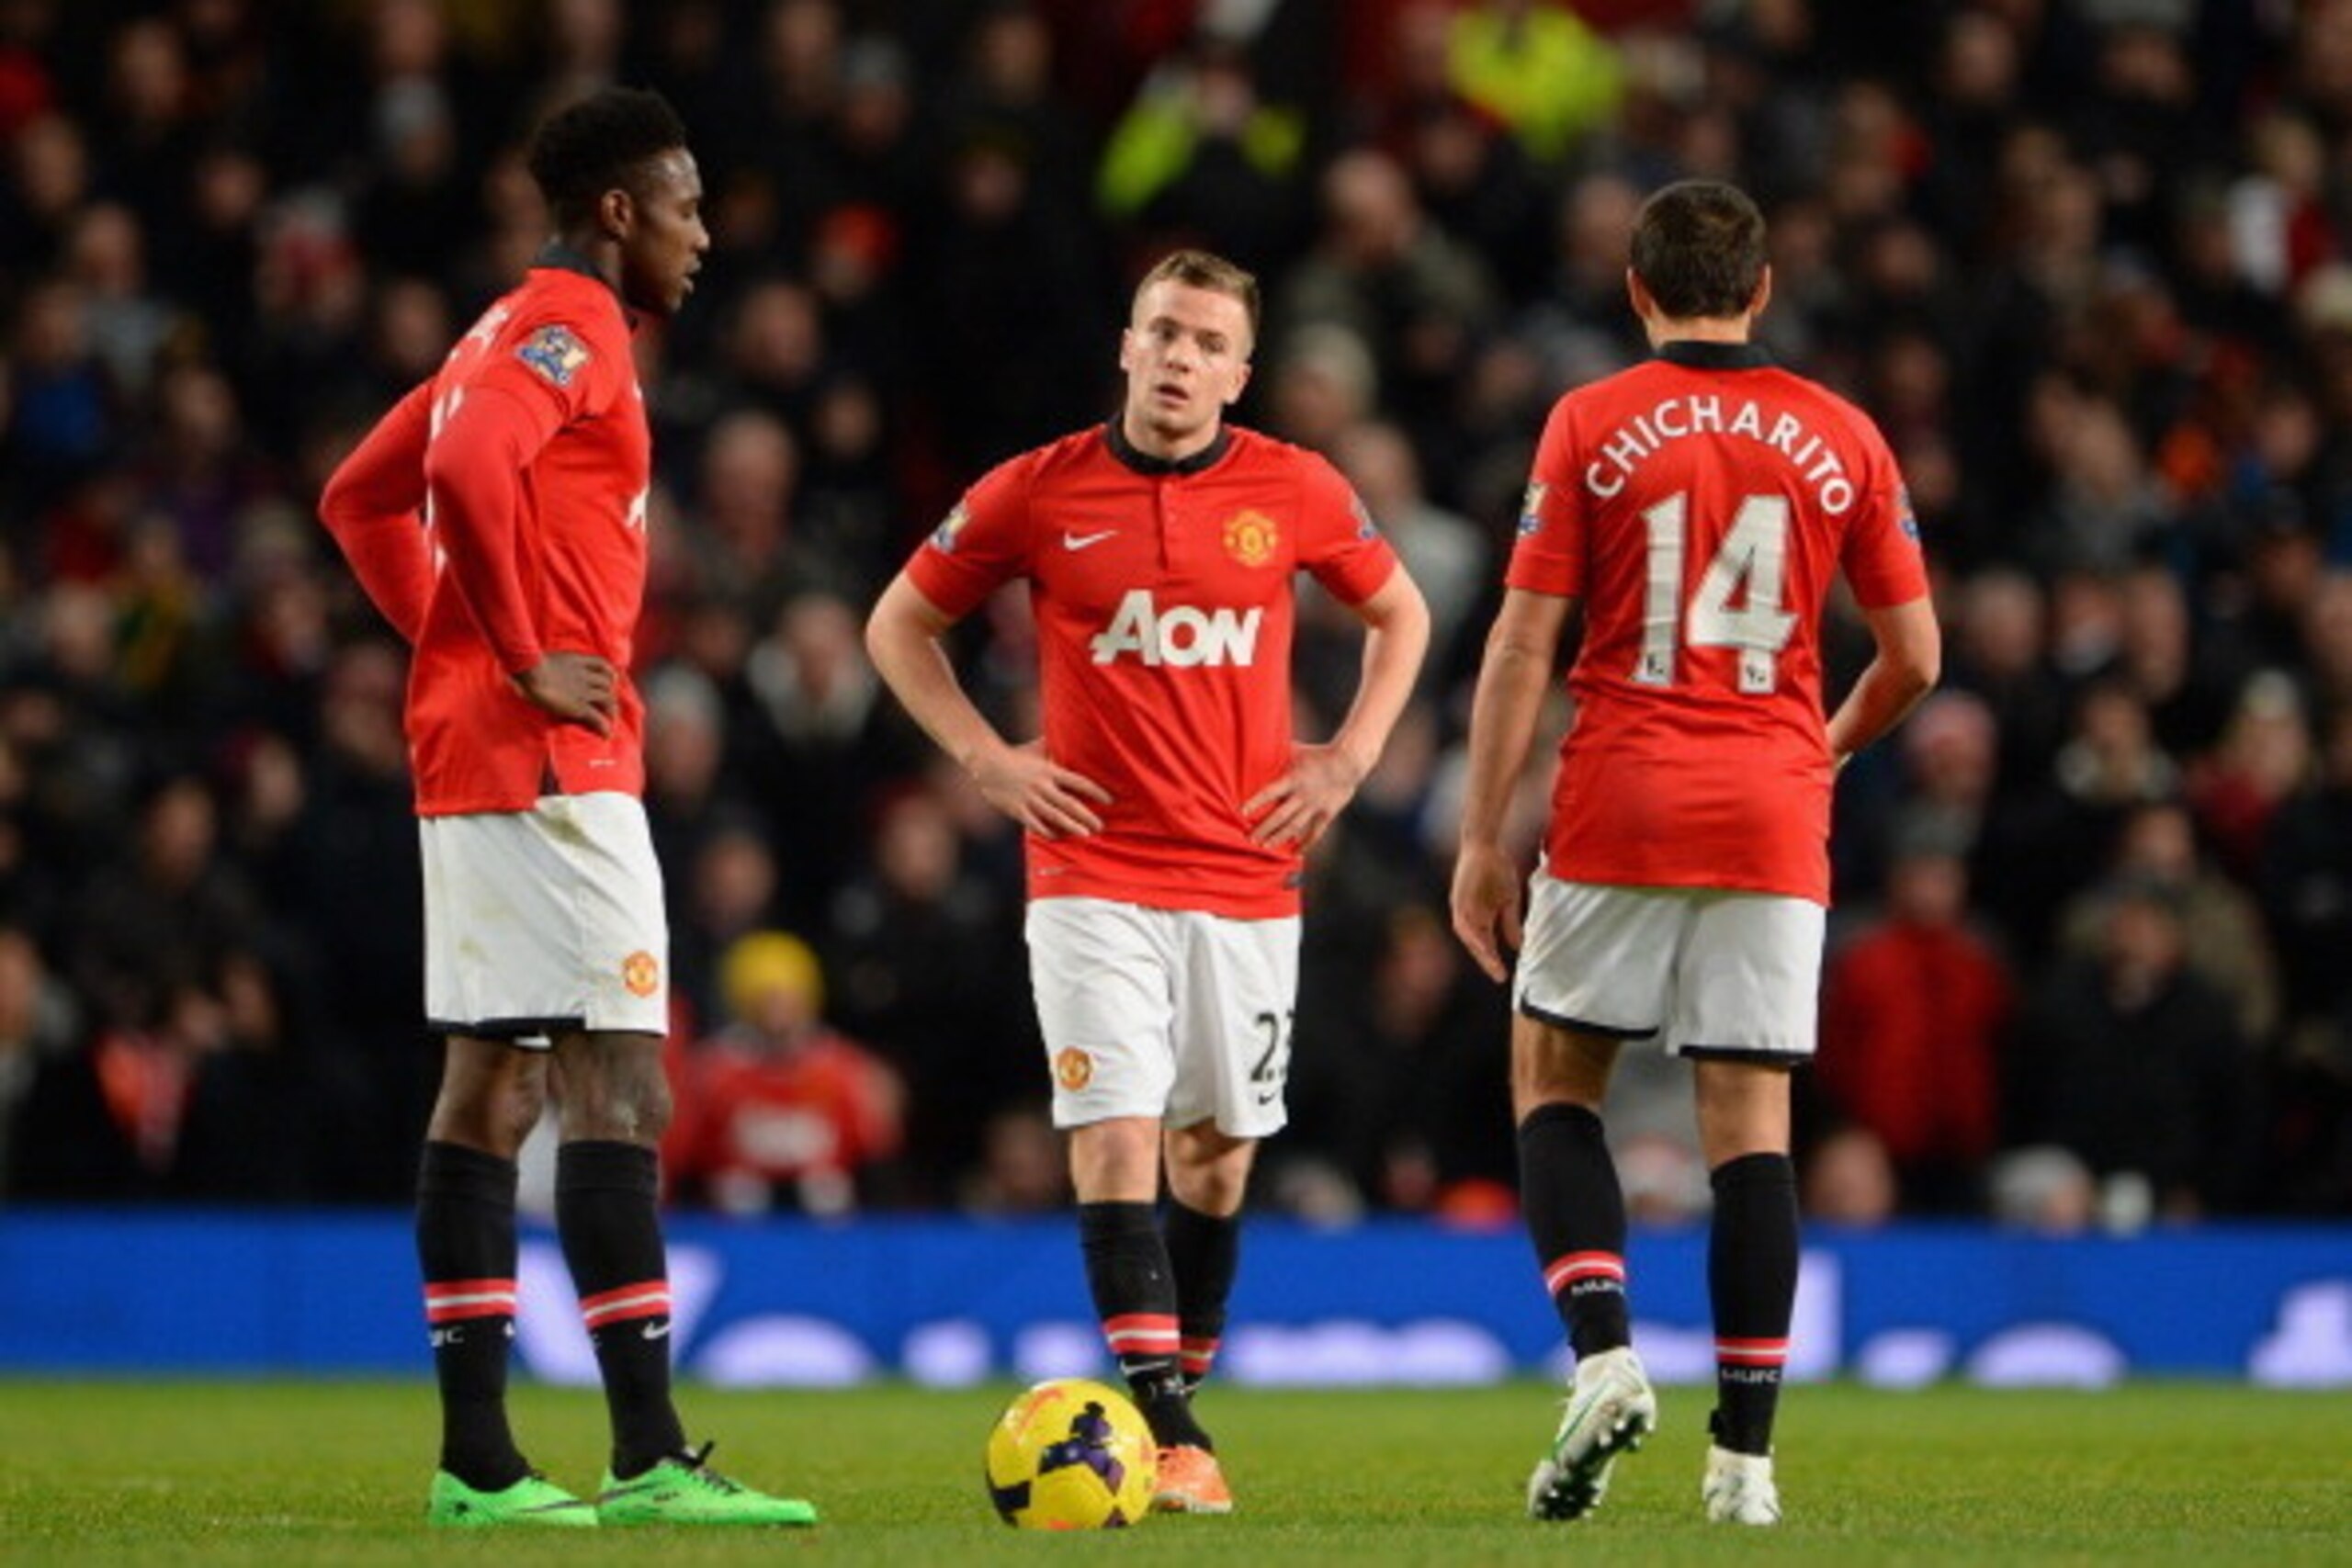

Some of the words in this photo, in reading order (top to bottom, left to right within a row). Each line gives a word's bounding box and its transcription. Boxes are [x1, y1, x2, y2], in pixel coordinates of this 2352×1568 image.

[1587, 396, 1854, 514] CHICHARITO
[1090, 589, 1263, 668] AON
[1629, 490, 1800, 694] 14
